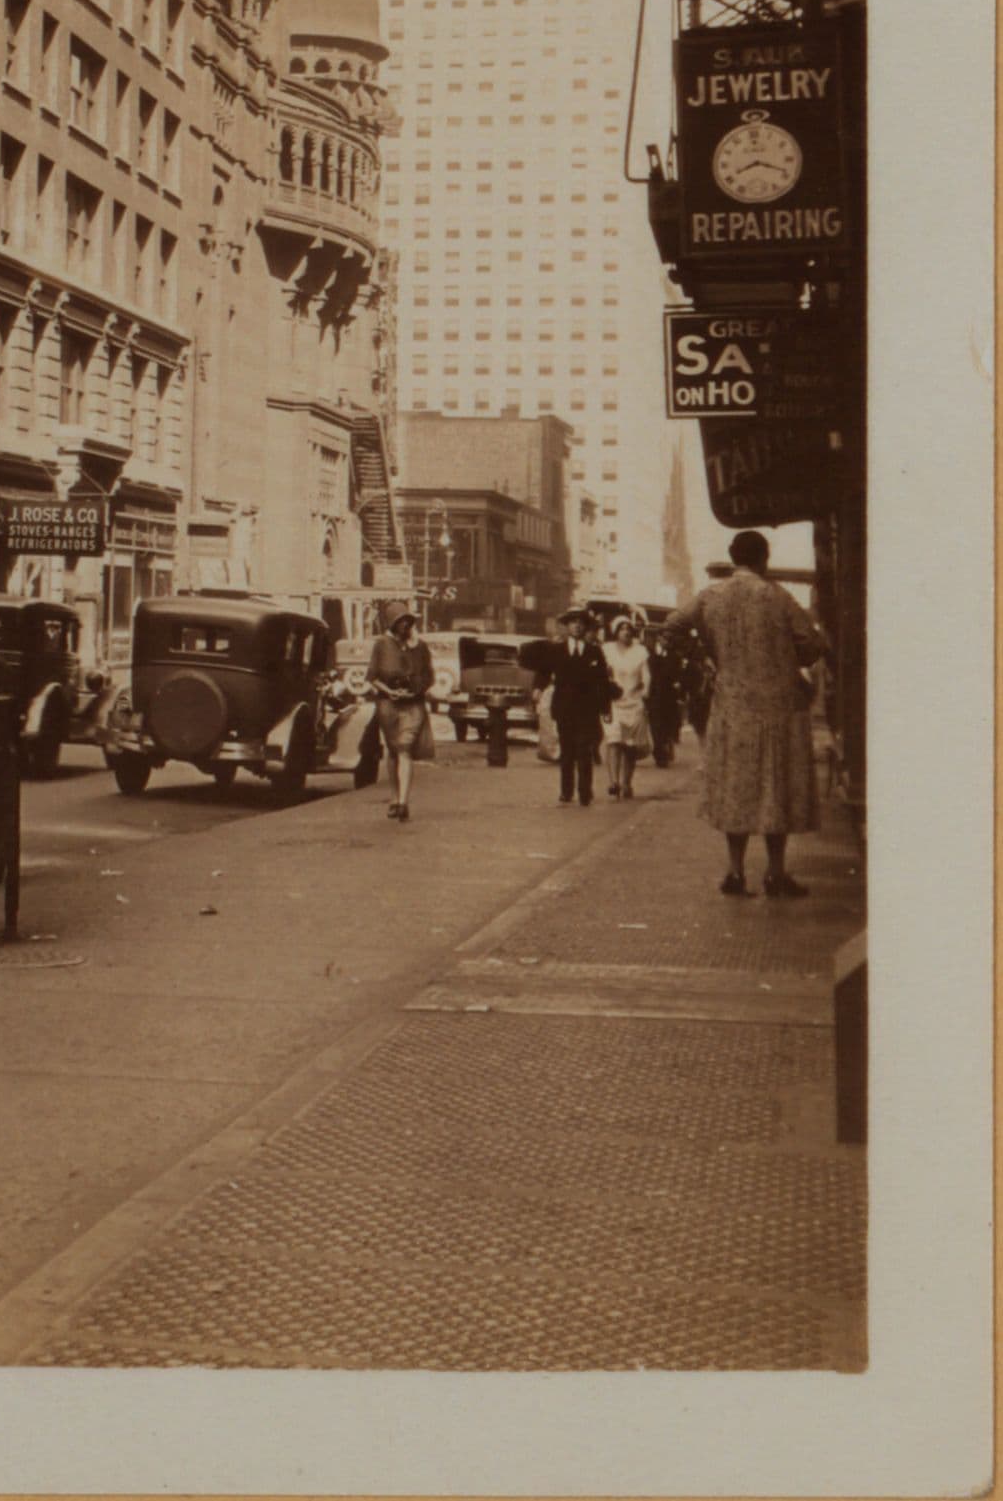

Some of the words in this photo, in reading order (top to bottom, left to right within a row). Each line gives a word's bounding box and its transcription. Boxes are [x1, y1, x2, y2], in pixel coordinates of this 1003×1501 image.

[687, 68, 832, 108] JEWELRY
[692, 205, 844, 244] REPAIRING
[675, 387, 705, 406] ON
[22, 506, 60, 523] ROSE
[63, 508, 74, 523] &
[7, 537, 97, 552] REFRIGERATORS
